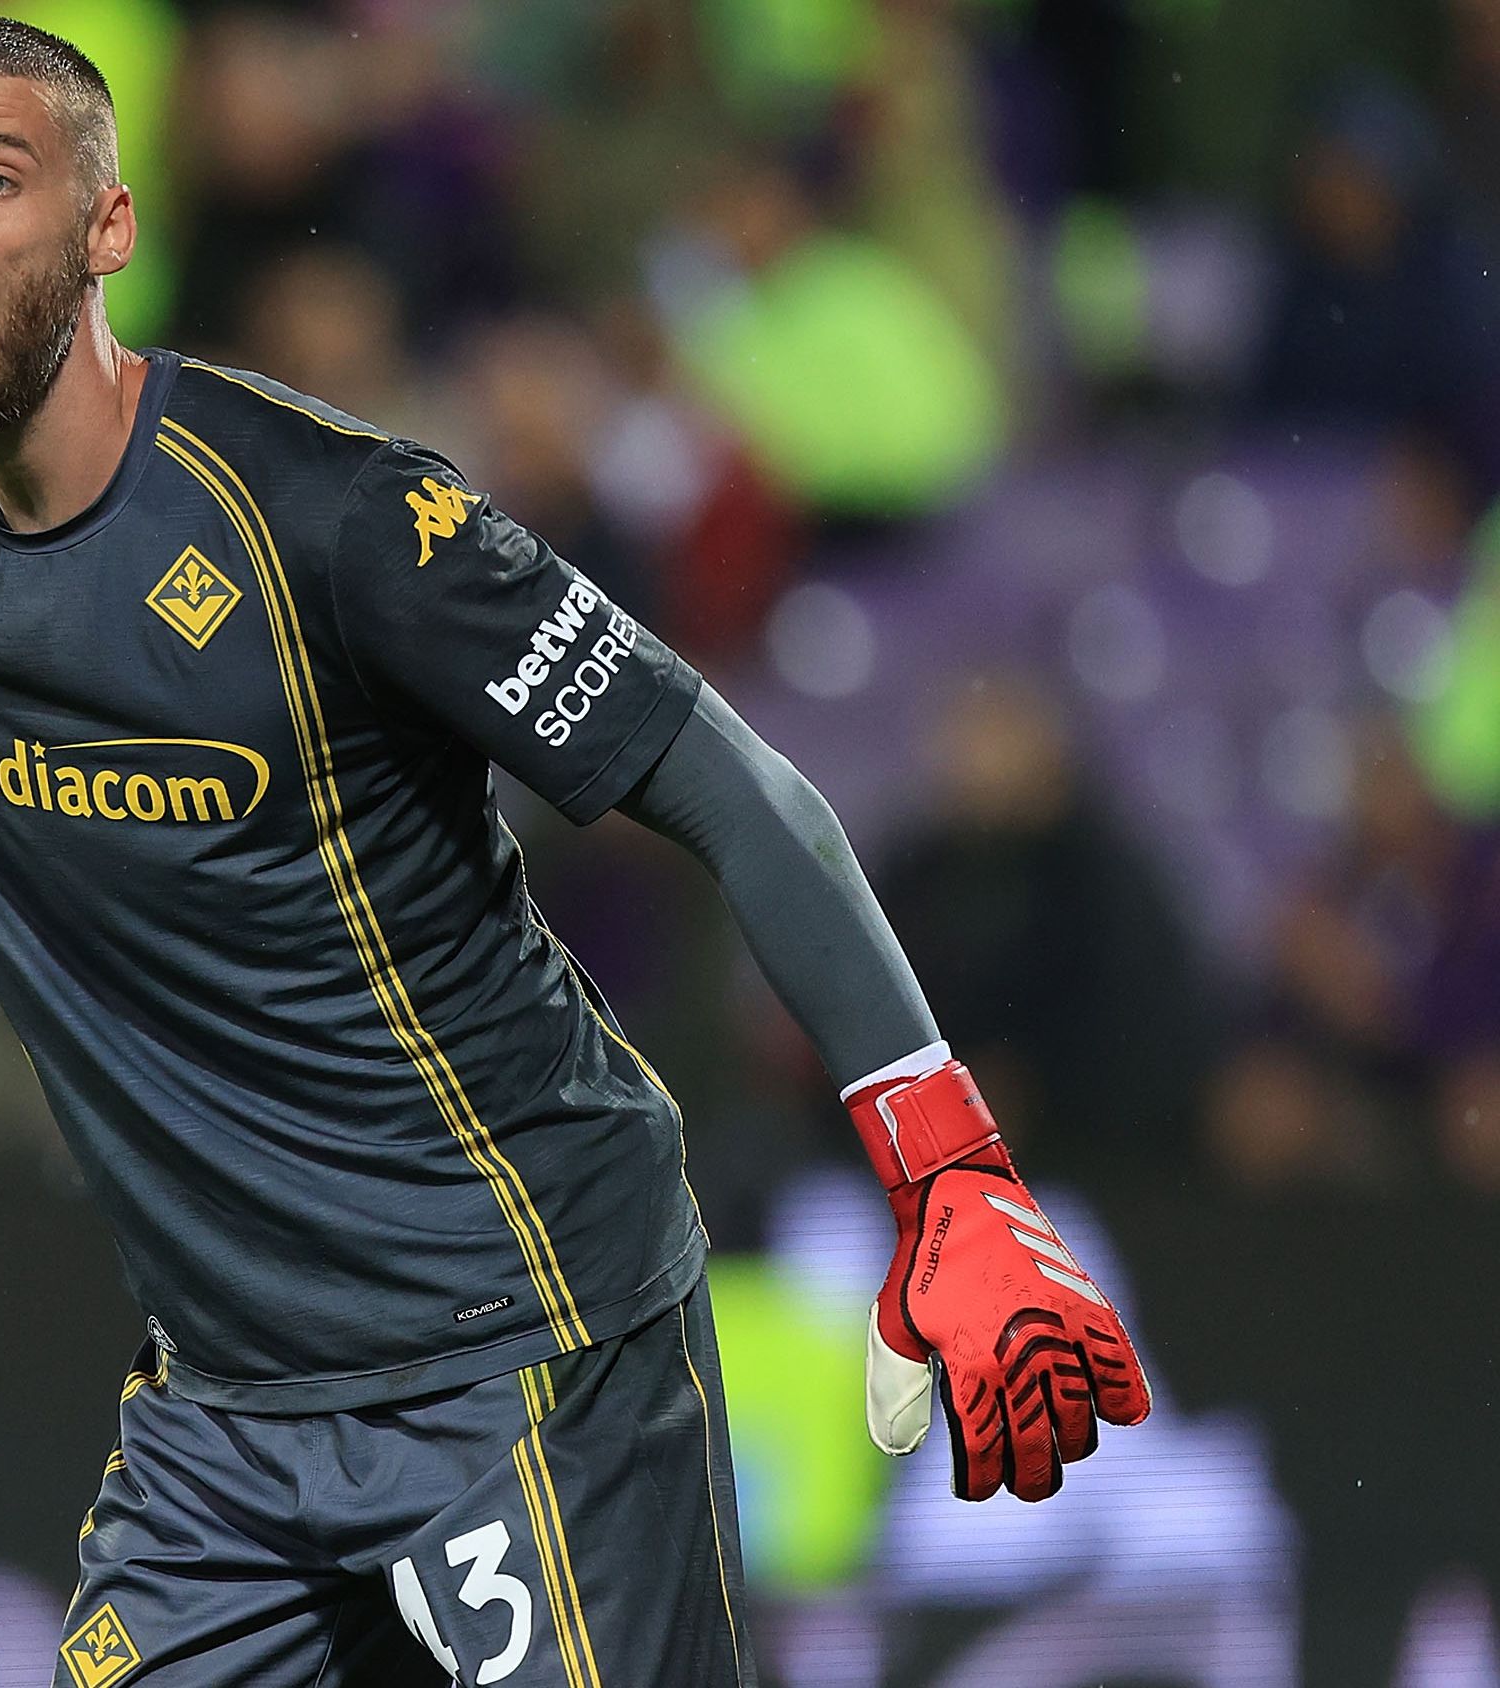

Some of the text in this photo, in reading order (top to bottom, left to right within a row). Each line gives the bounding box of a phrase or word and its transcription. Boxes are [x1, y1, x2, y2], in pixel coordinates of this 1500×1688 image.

[484, 566, 609, 716] betway
[916, 1205, 955, 1295] PREDATOR
[456, 1296, 509, 1321] KOMBAT
